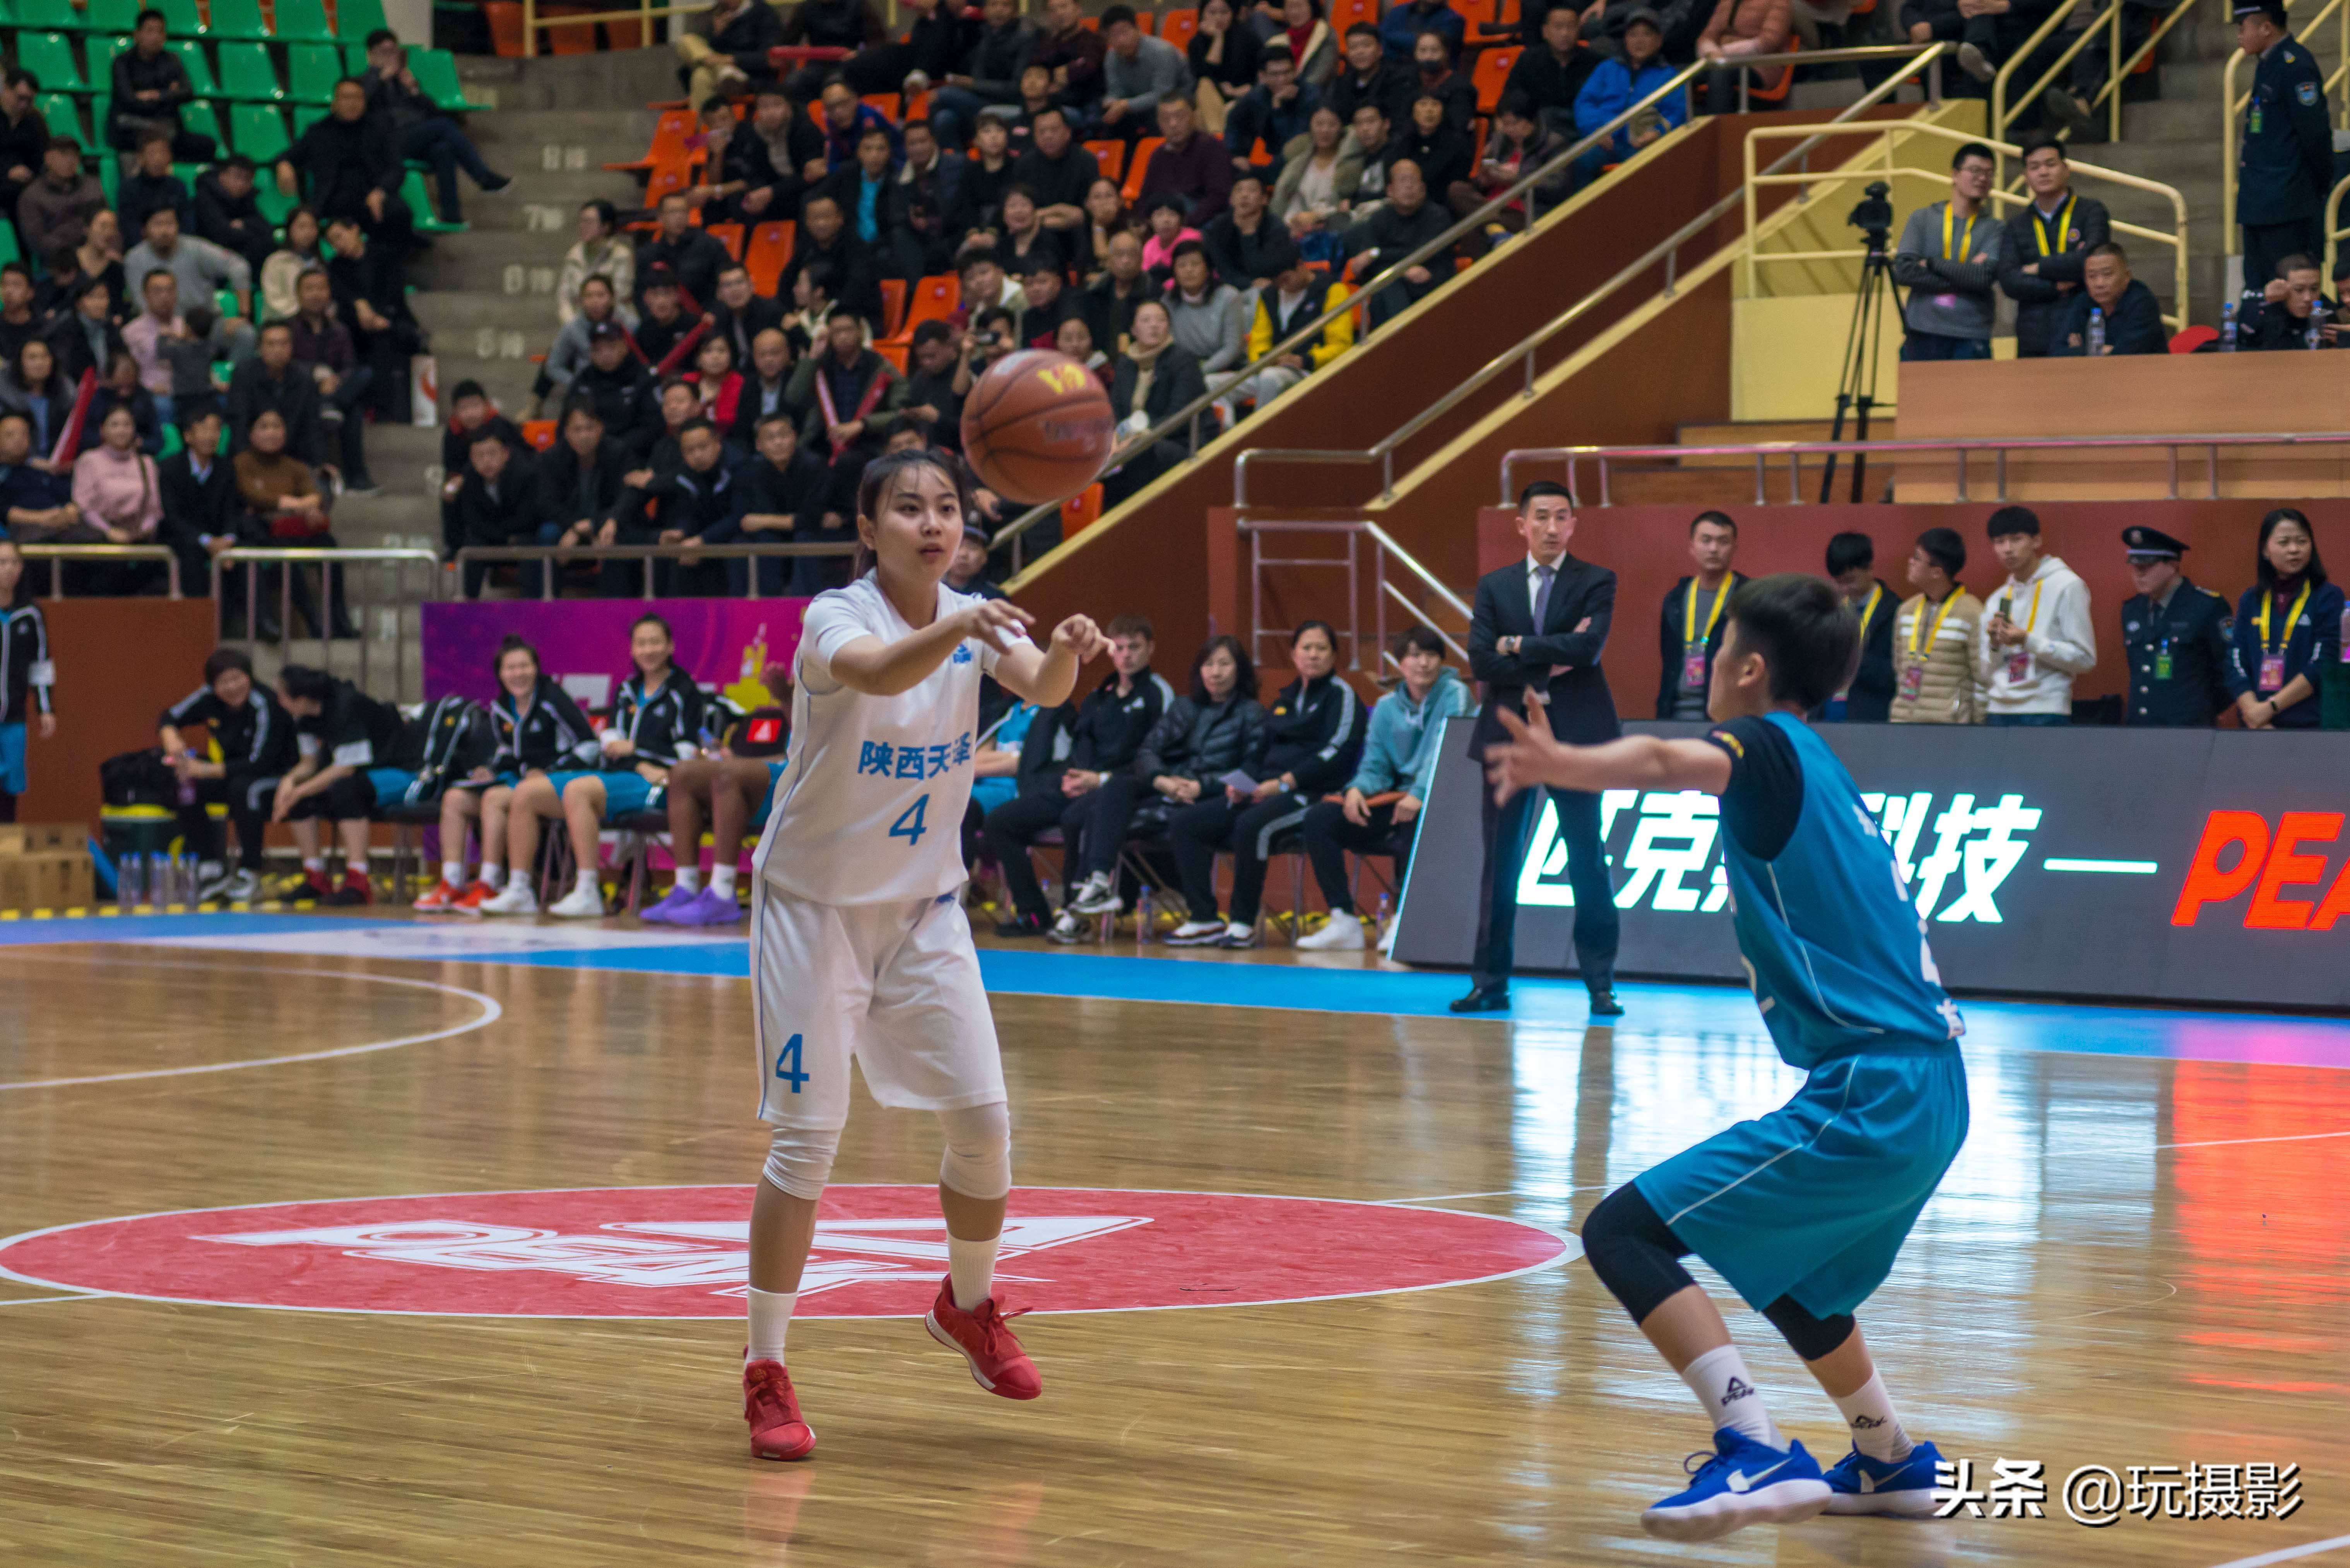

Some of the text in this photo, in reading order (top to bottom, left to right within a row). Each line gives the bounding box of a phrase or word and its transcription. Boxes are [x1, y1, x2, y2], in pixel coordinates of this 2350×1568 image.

[857, 731, 971, 781] 陕西天泽
[888, 793, 930, 846] 4
[775, 1033, 809, 1093] 4
